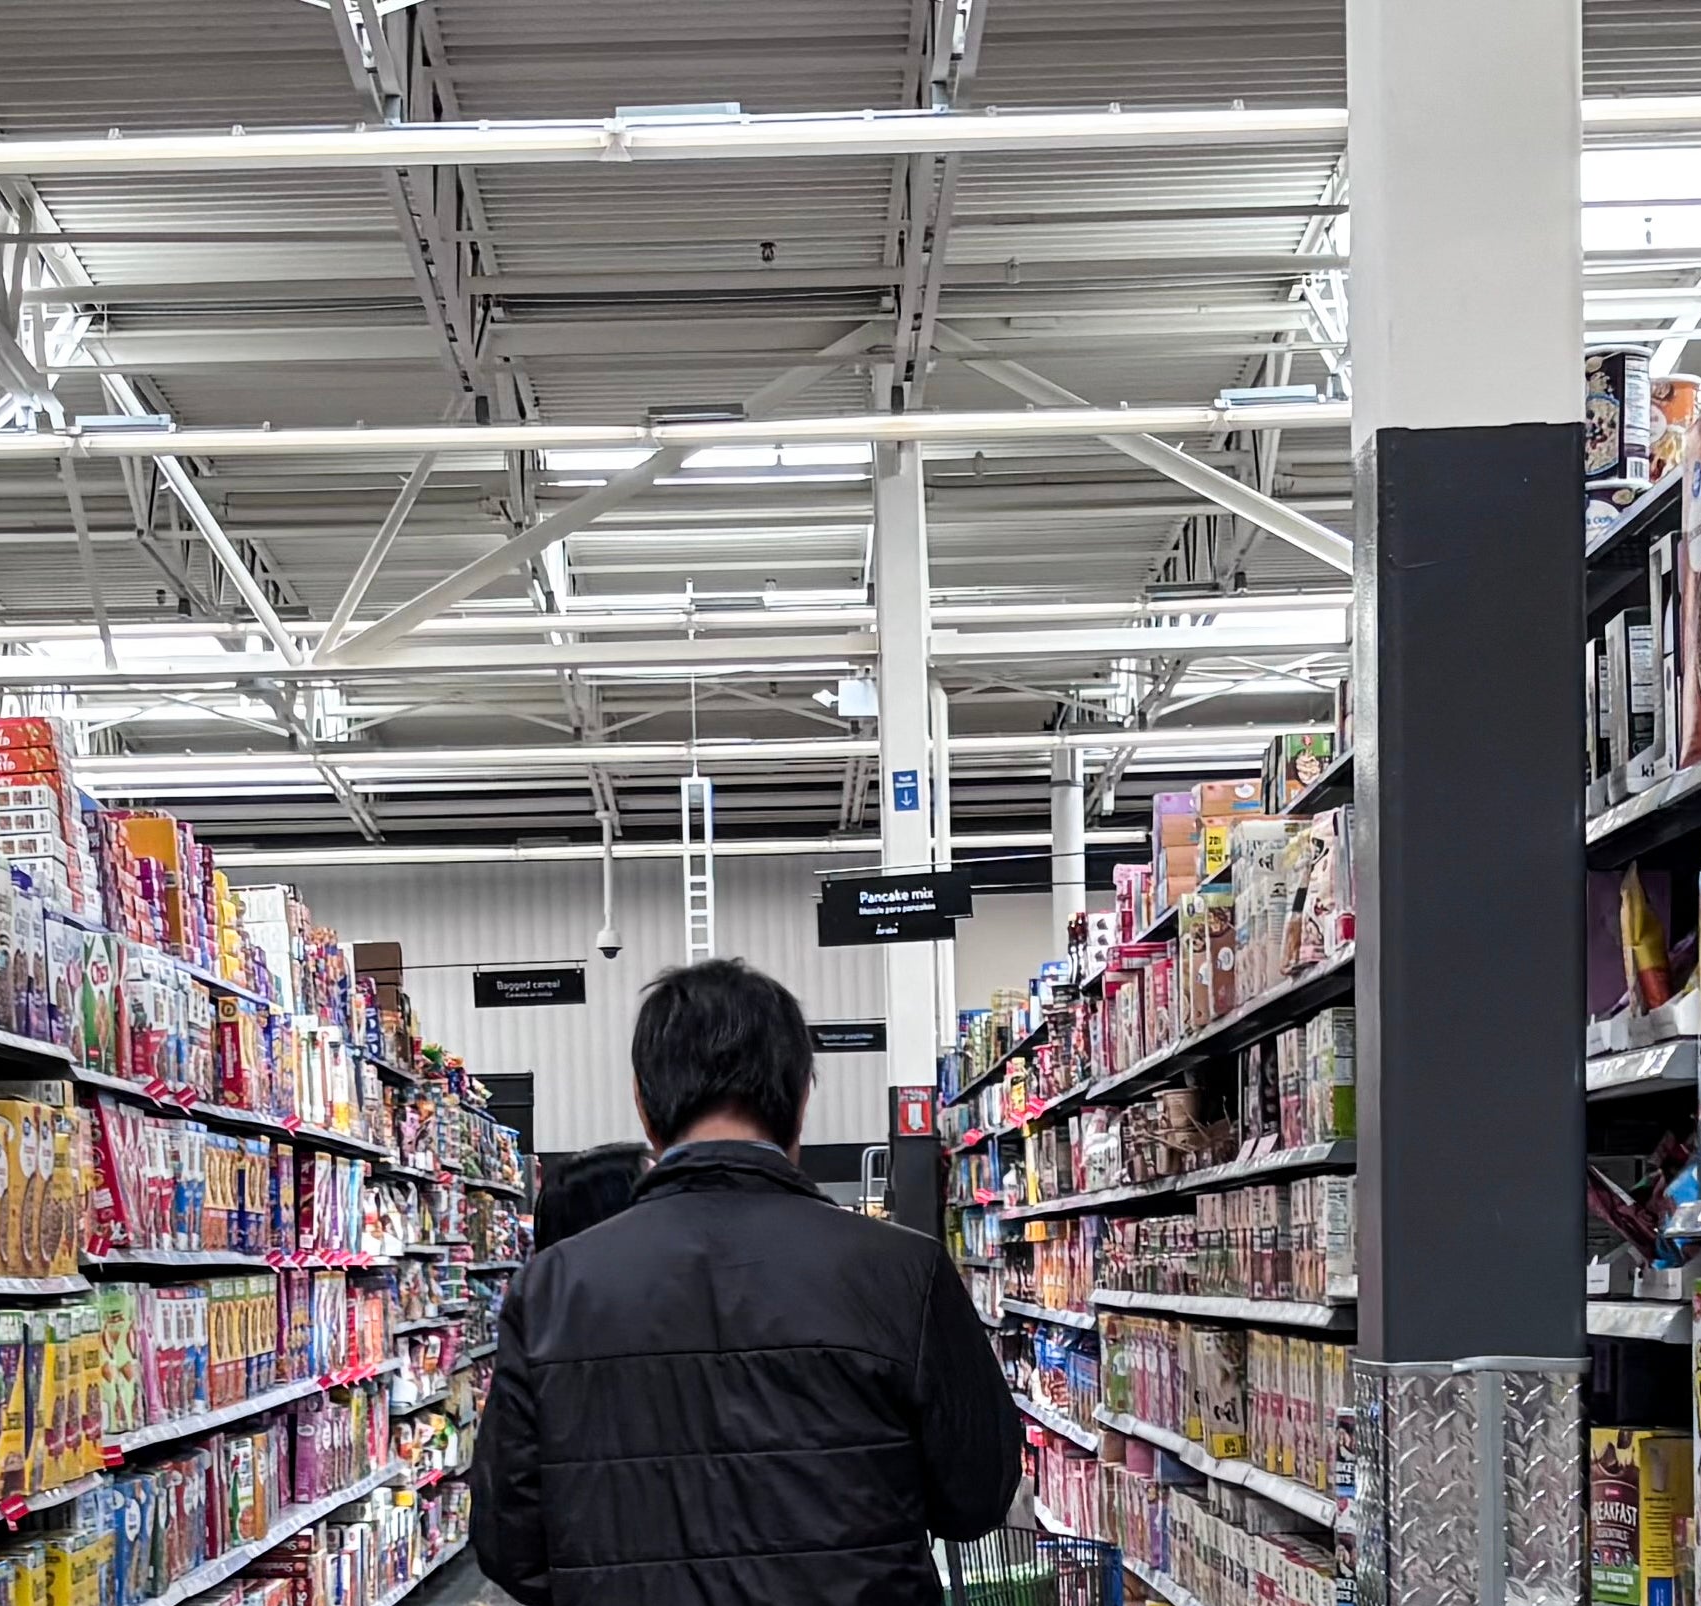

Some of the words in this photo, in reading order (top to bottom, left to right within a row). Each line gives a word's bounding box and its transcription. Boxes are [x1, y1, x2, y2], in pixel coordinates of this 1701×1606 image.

[859, 889, 909, 904] Pancake
[911, 887, 934, 900] mix
[496, 981, 531, 991] Bagged
[533, 980, 561, 989] cereal
